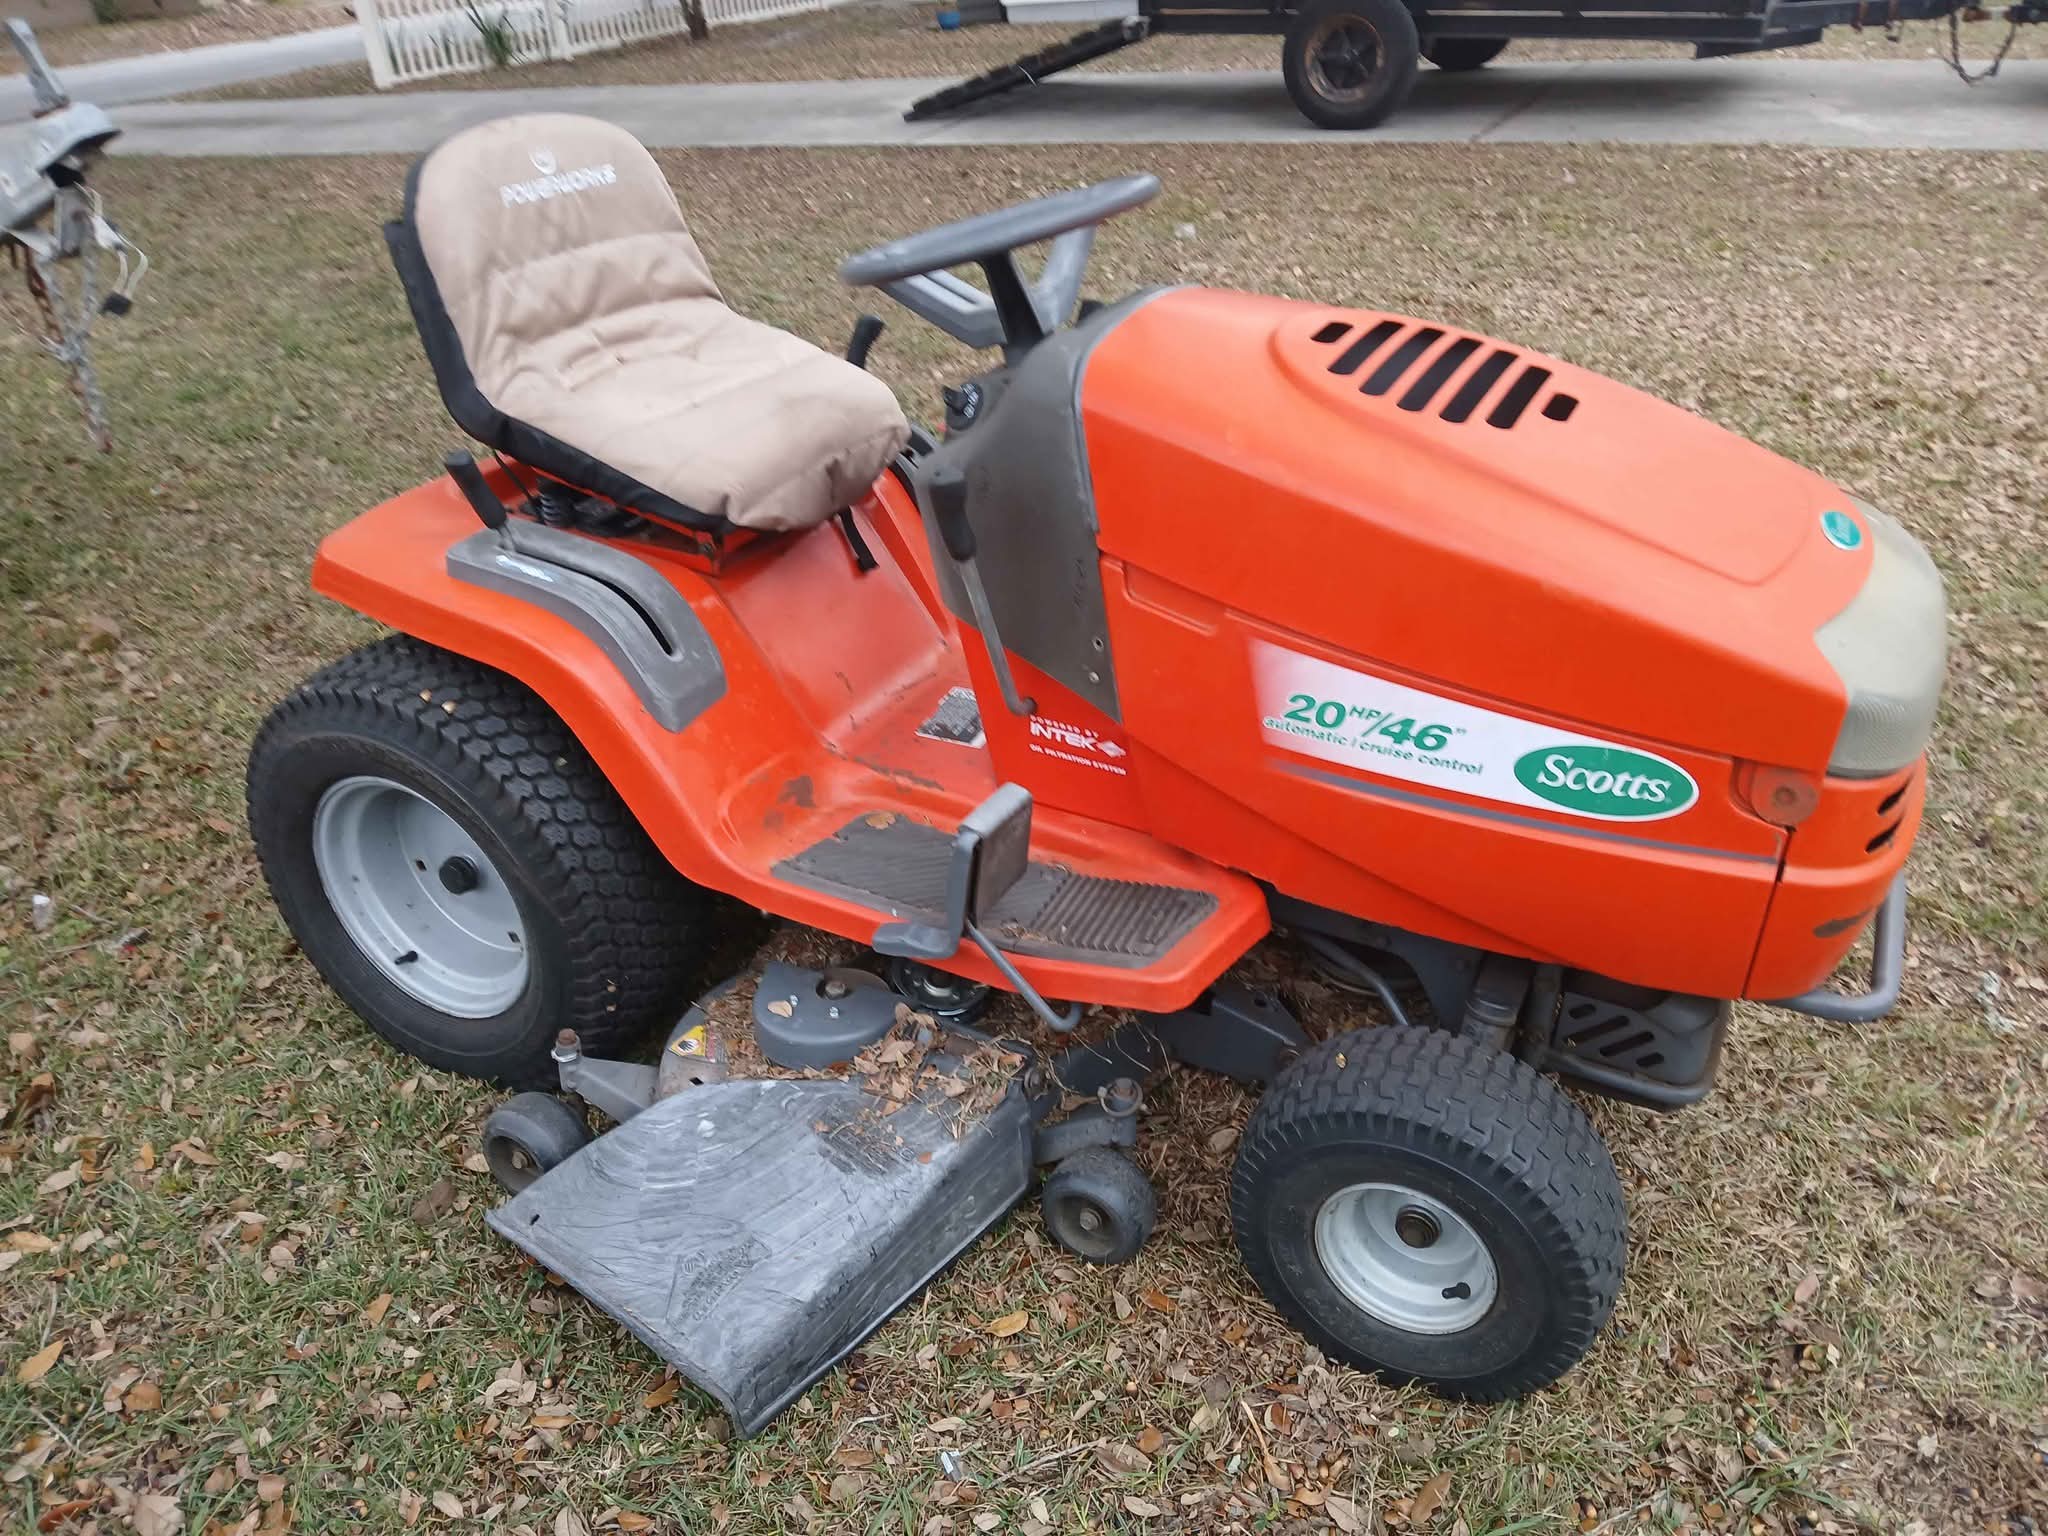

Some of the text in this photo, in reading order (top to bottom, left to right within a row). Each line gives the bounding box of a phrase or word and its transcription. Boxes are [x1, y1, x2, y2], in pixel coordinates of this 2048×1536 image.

[1264, 718, 1349, 746] automatic
[1359, 741, 1414, 760] cruise
[1418, 754, 1484, 775] control
[1535, 753, 1673, 803] Scotts
